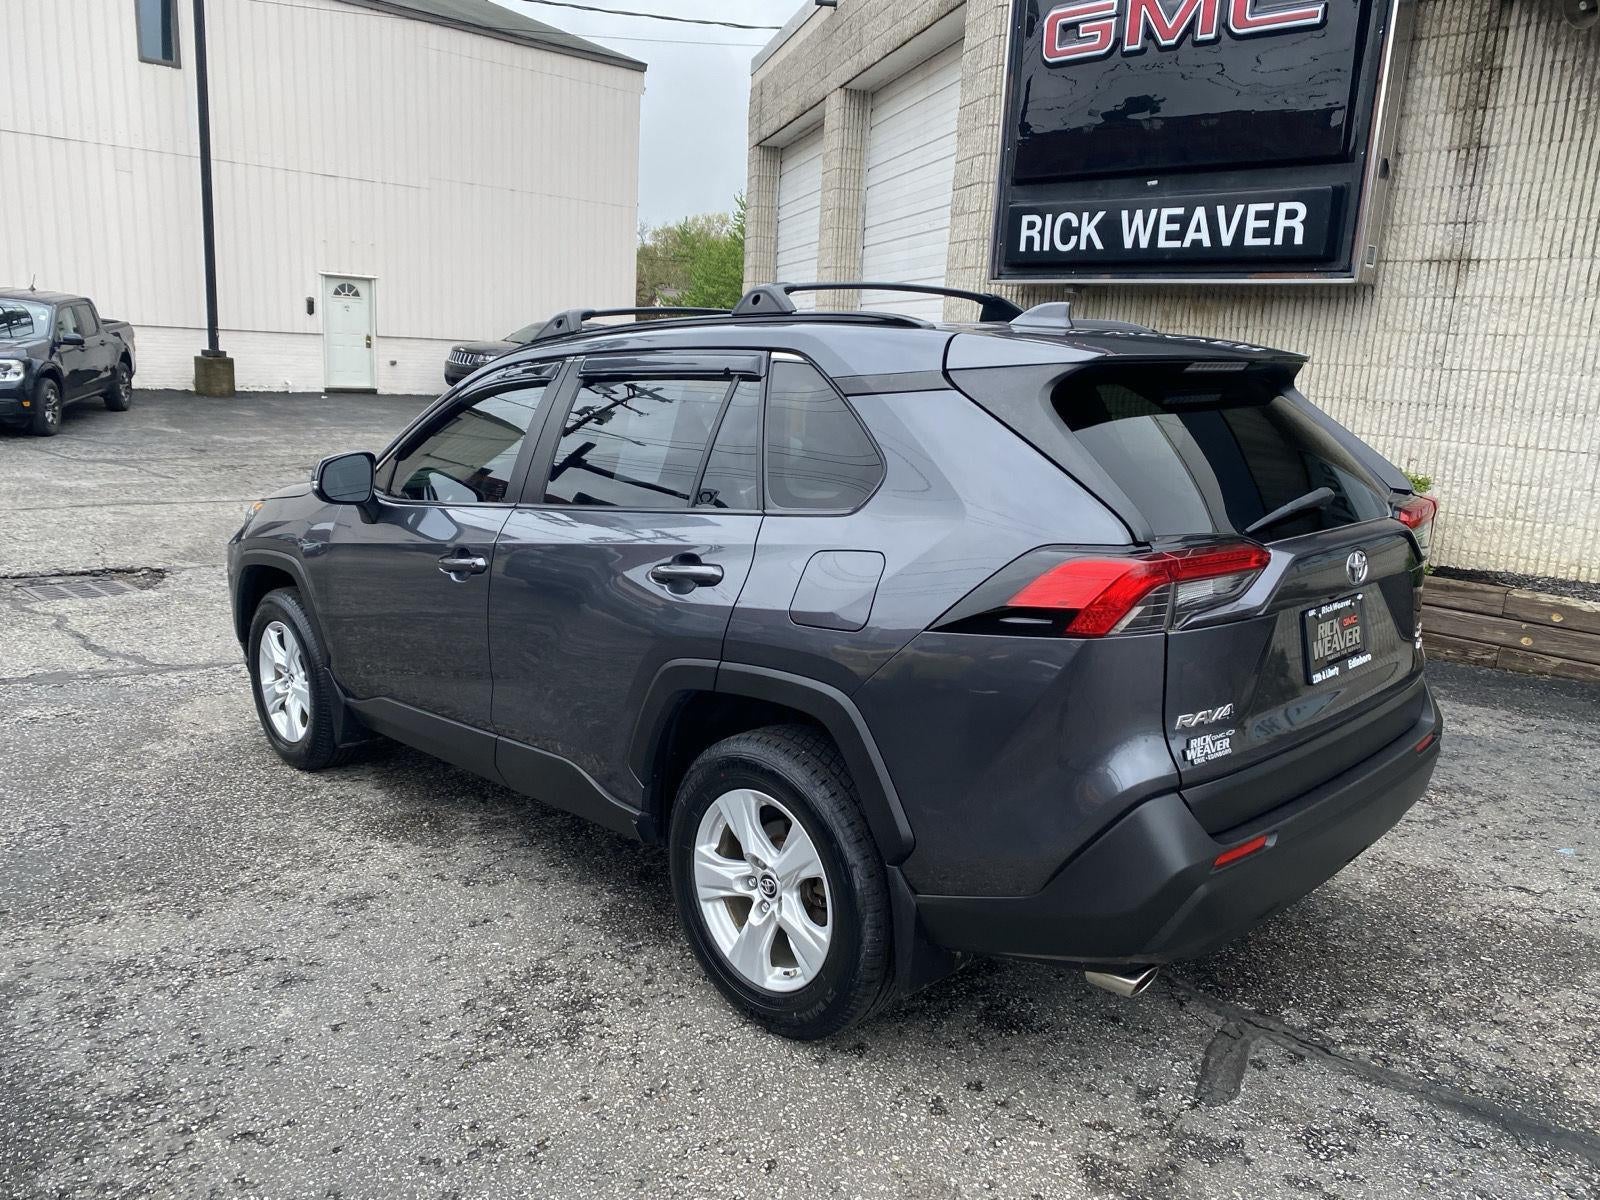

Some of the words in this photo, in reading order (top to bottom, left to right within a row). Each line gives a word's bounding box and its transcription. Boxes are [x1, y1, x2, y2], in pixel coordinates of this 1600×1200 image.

[1043, 0, 1325, 62] GMC
[1019, 210, 1106, 252] RICK
[1122, 201, 1307, 249] WEAVER
[1318, 617, 1340, 639] RICK
[1313, 626, 1361, 660] WEAVER
[1174, 703, 1234, 730] RAV4
[1186, 738, 1230, 760] WEAVER
[1191, 734, 1212, 748] RICK
